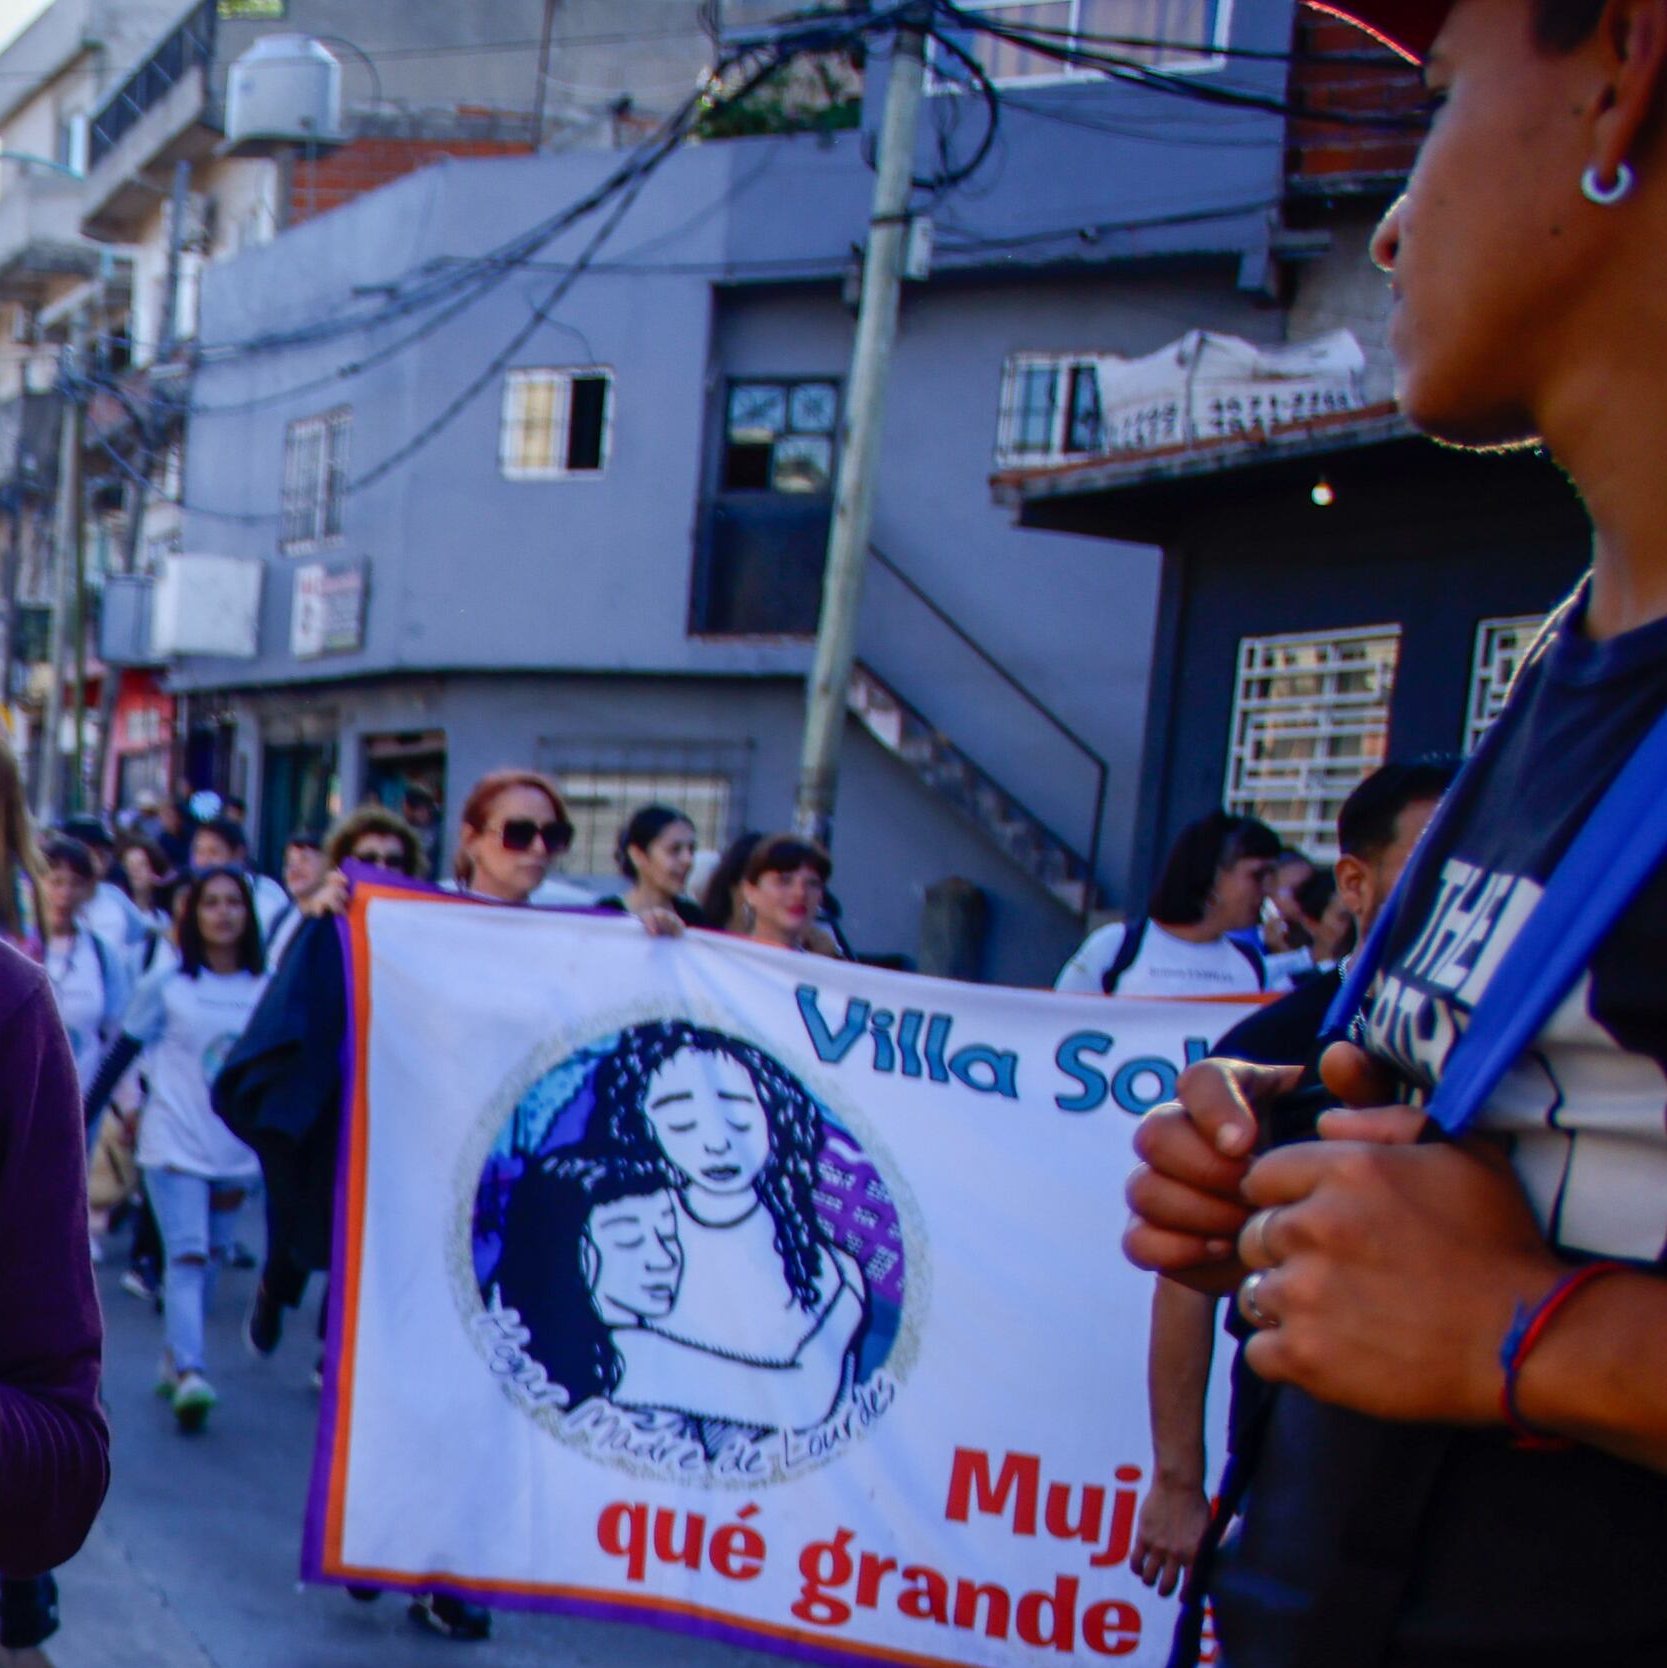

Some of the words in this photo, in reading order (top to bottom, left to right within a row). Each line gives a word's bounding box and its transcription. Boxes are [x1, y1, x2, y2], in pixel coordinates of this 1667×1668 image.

[795, 983, 1019, 1099] Villa
[569, 1403, 703, 1470] Madre
[720, 1444, 762, 1474] de
[783, 1374, 895, 1467] Lourdes
[596, 1500, 766, 1582] qué
[790, 1526, 1143, 1656] grande
